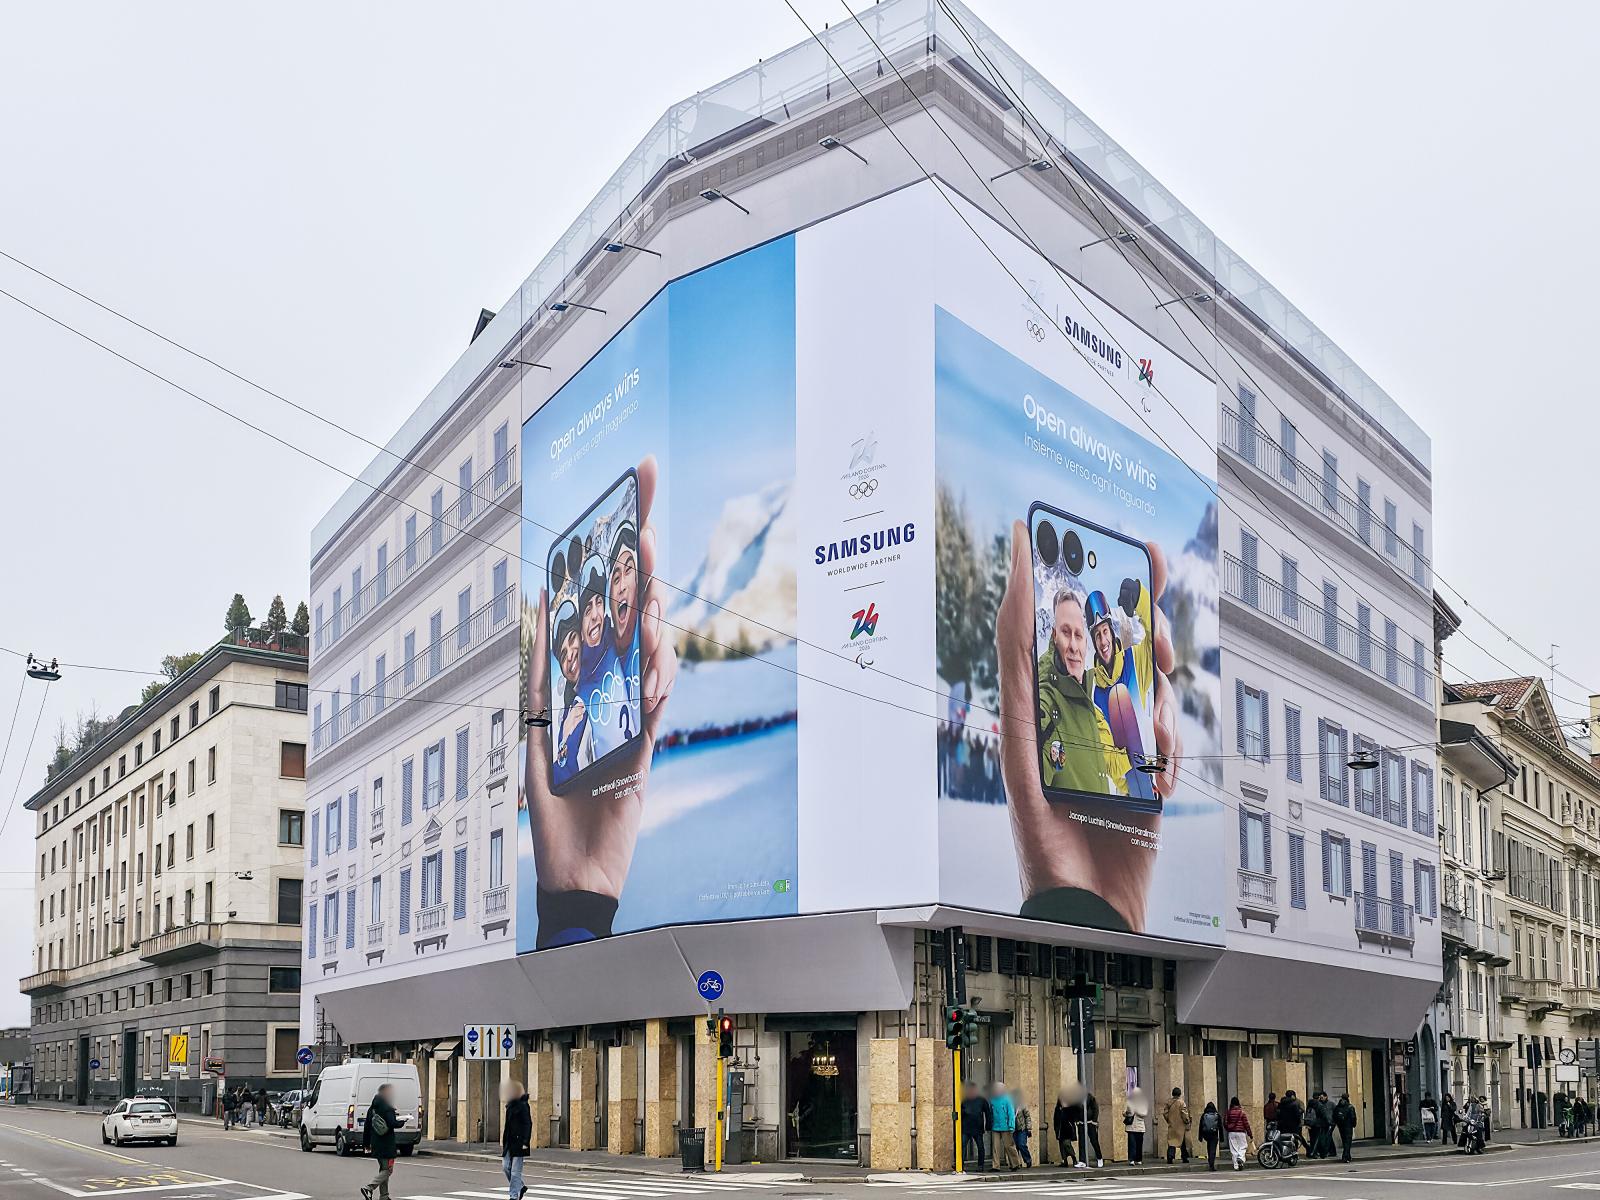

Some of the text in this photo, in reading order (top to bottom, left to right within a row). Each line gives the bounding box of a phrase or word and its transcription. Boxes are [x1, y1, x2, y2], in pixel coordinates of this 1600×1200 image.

[1065, 315, 1122, 369] SAMSUNG
[550, 367, 640, 461] Open always wins
[605, 400, 639, 435] traguardo
[1023, 393, 1158, 491] Open always wins
[1024, 431, 1156, 517] Insieme verso ogni traguardo
[814, 522, 915, 565] SAMSUNG
[827, 553, 901, 577] WORLDWIDE PARTNER
[864, 634, 889, 645] CORTINA
[1069, 810, 1088, 824] Jacopo
[1088, 815, 1106, 827] Luchini
[1105, 820, 1135, 834] (Snowboard
[1130, 837, 1140, 846] con
